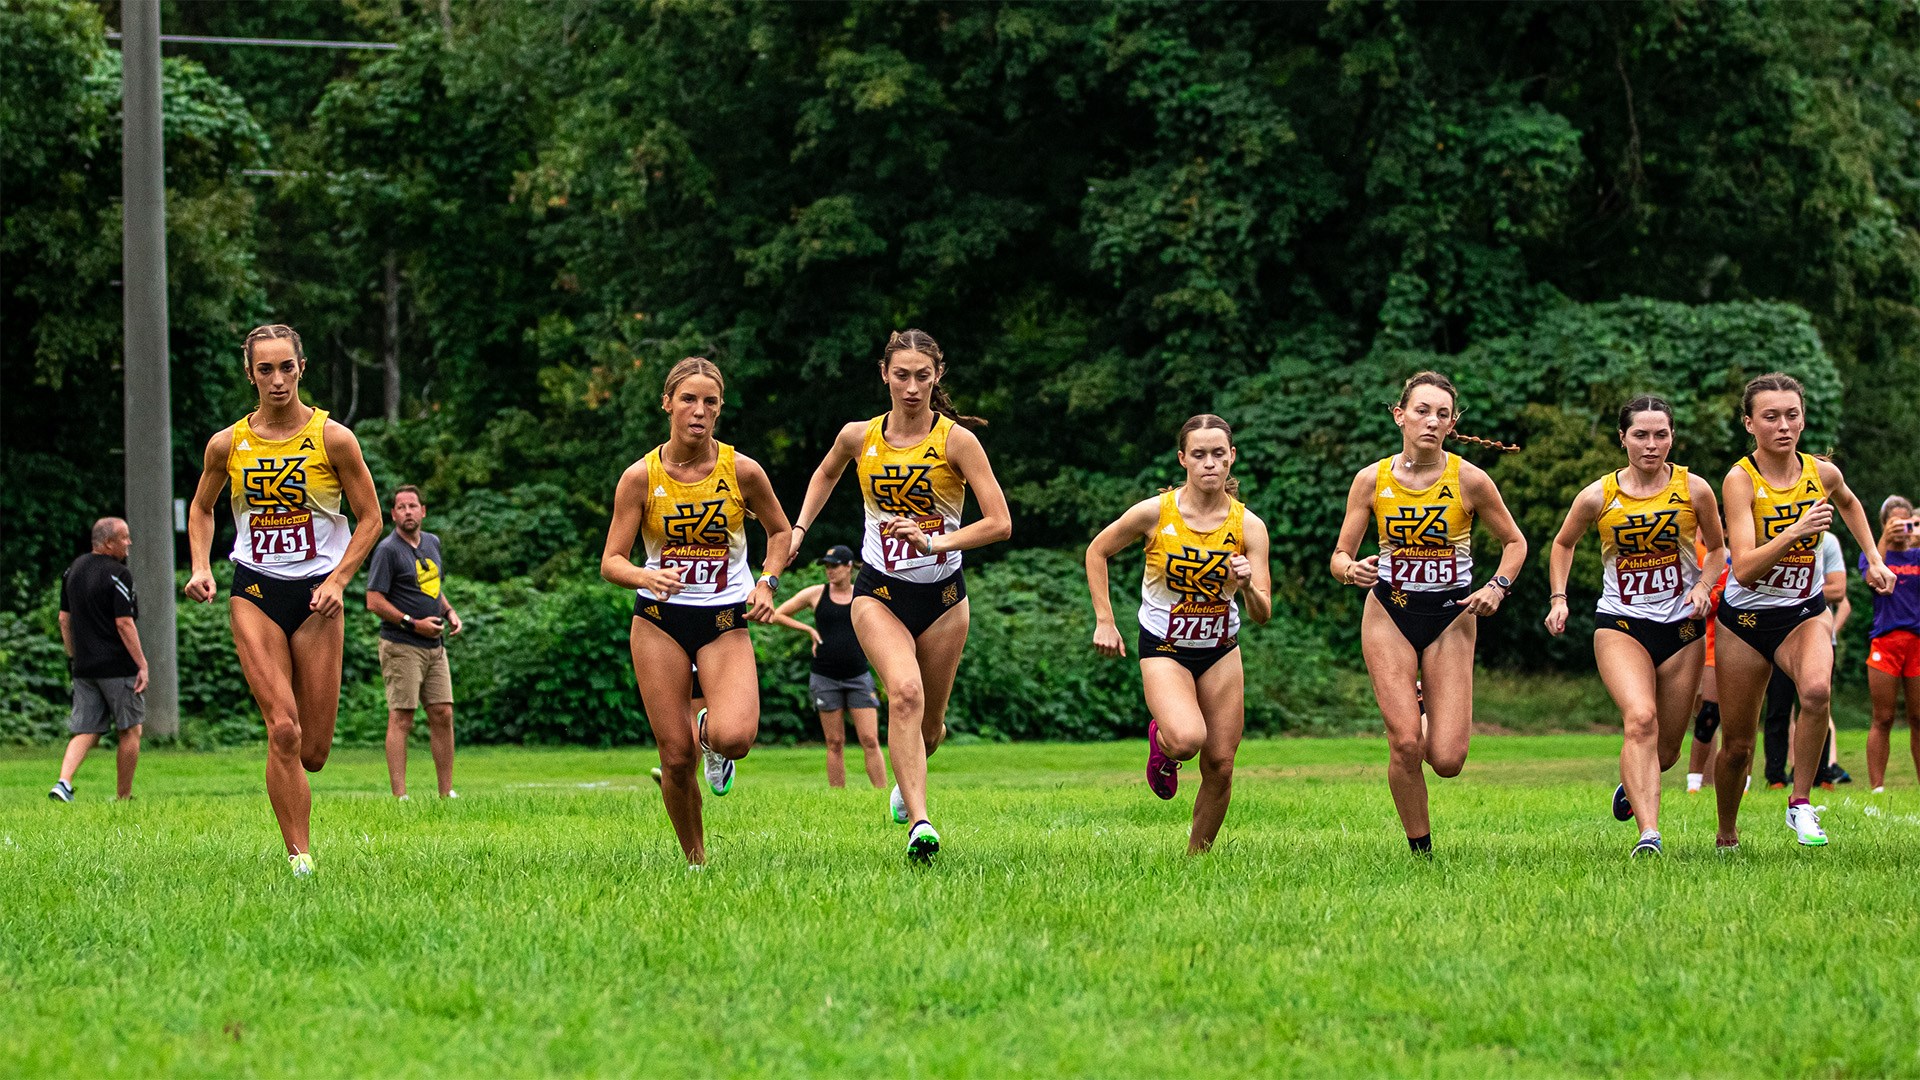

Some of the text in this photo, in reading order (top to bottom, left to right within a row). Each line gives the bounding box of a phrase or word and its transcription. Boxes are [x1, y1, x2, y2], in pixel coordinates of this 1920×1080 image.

[251, 515, 293, 526] Athletic
[253, 527, 310, 554] 2751
[662, 546, 710, 556] Athletic
[885, 531, 940, 562] 27
[1392, 547, 1438, 557] Athletic
[1395, 560, 1453, 583] 2765
[1618, 557, 1662, 570] Athletic
[1621, 565, 1679, 596] 2749
[1755, 565, 1810, 590] 758
[1171, 603, 1215, 613] Athletic
[1170, 616, 1225, 640] 2754
